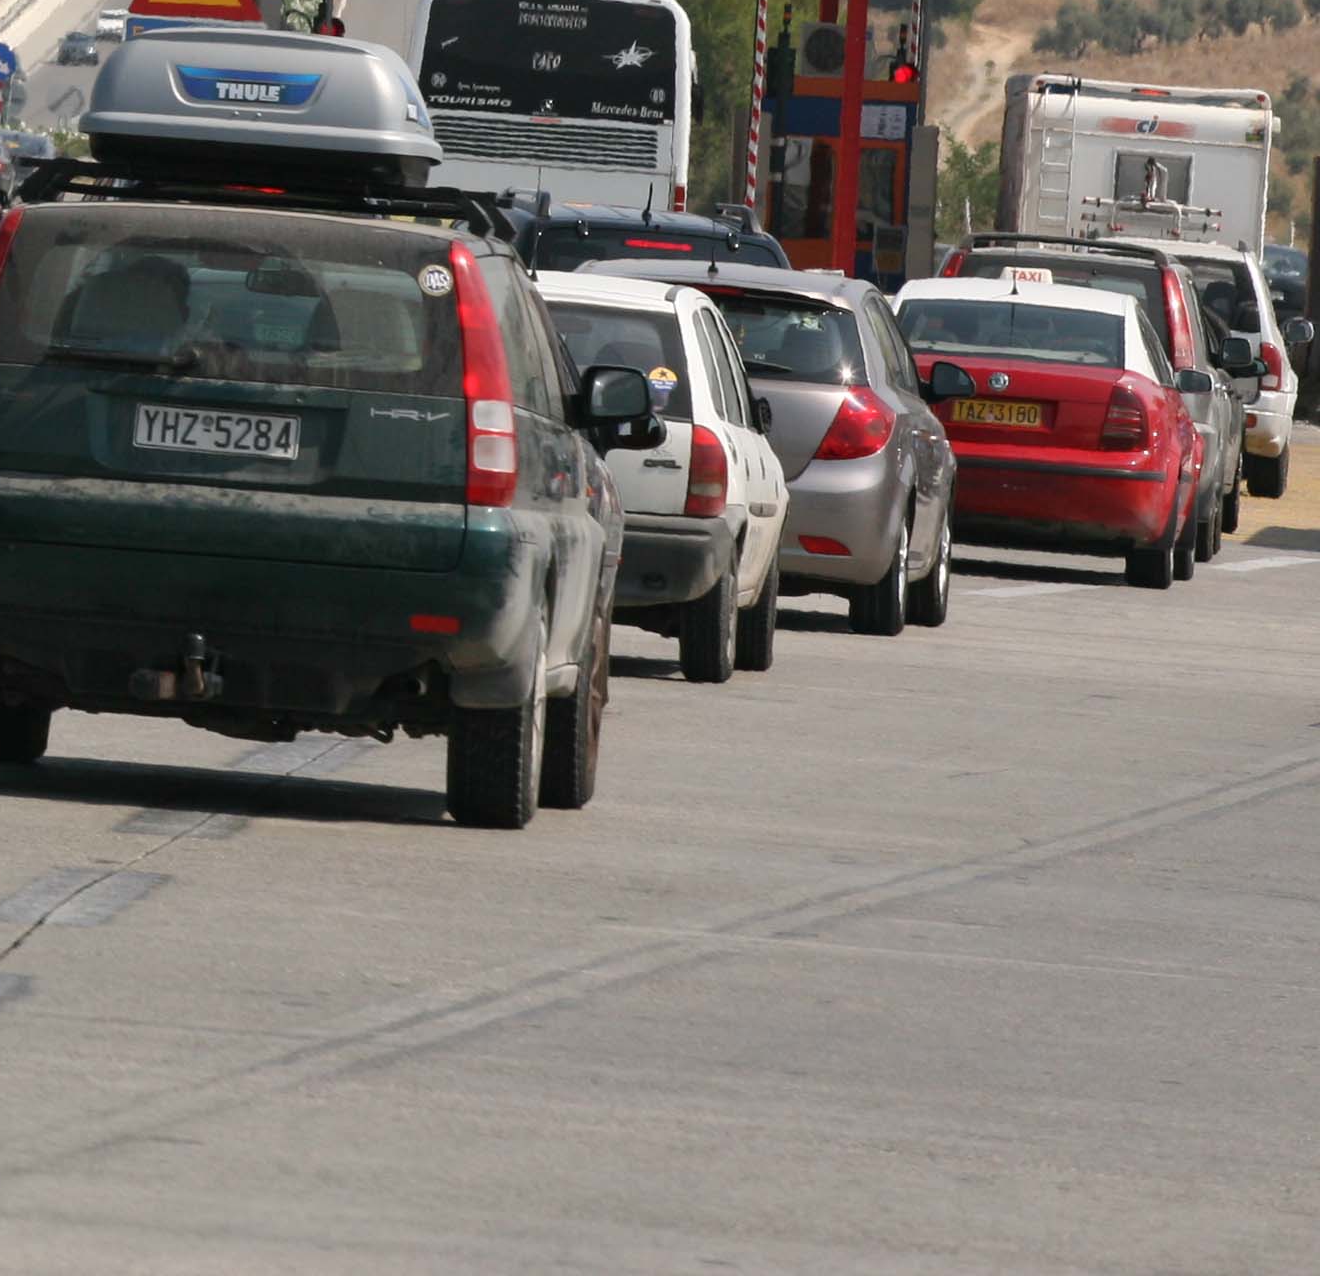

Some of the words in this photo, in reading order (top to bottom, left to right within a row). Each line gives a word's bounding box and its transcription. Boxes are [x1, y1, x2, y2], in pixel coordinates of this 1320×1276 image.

[216, 82, 281, 102] THULE
[428, 95, 512, 107] TOURISMO
[1011, 270, 1042, 283] TAXI
[370, 407, 451, 421] HR-V
